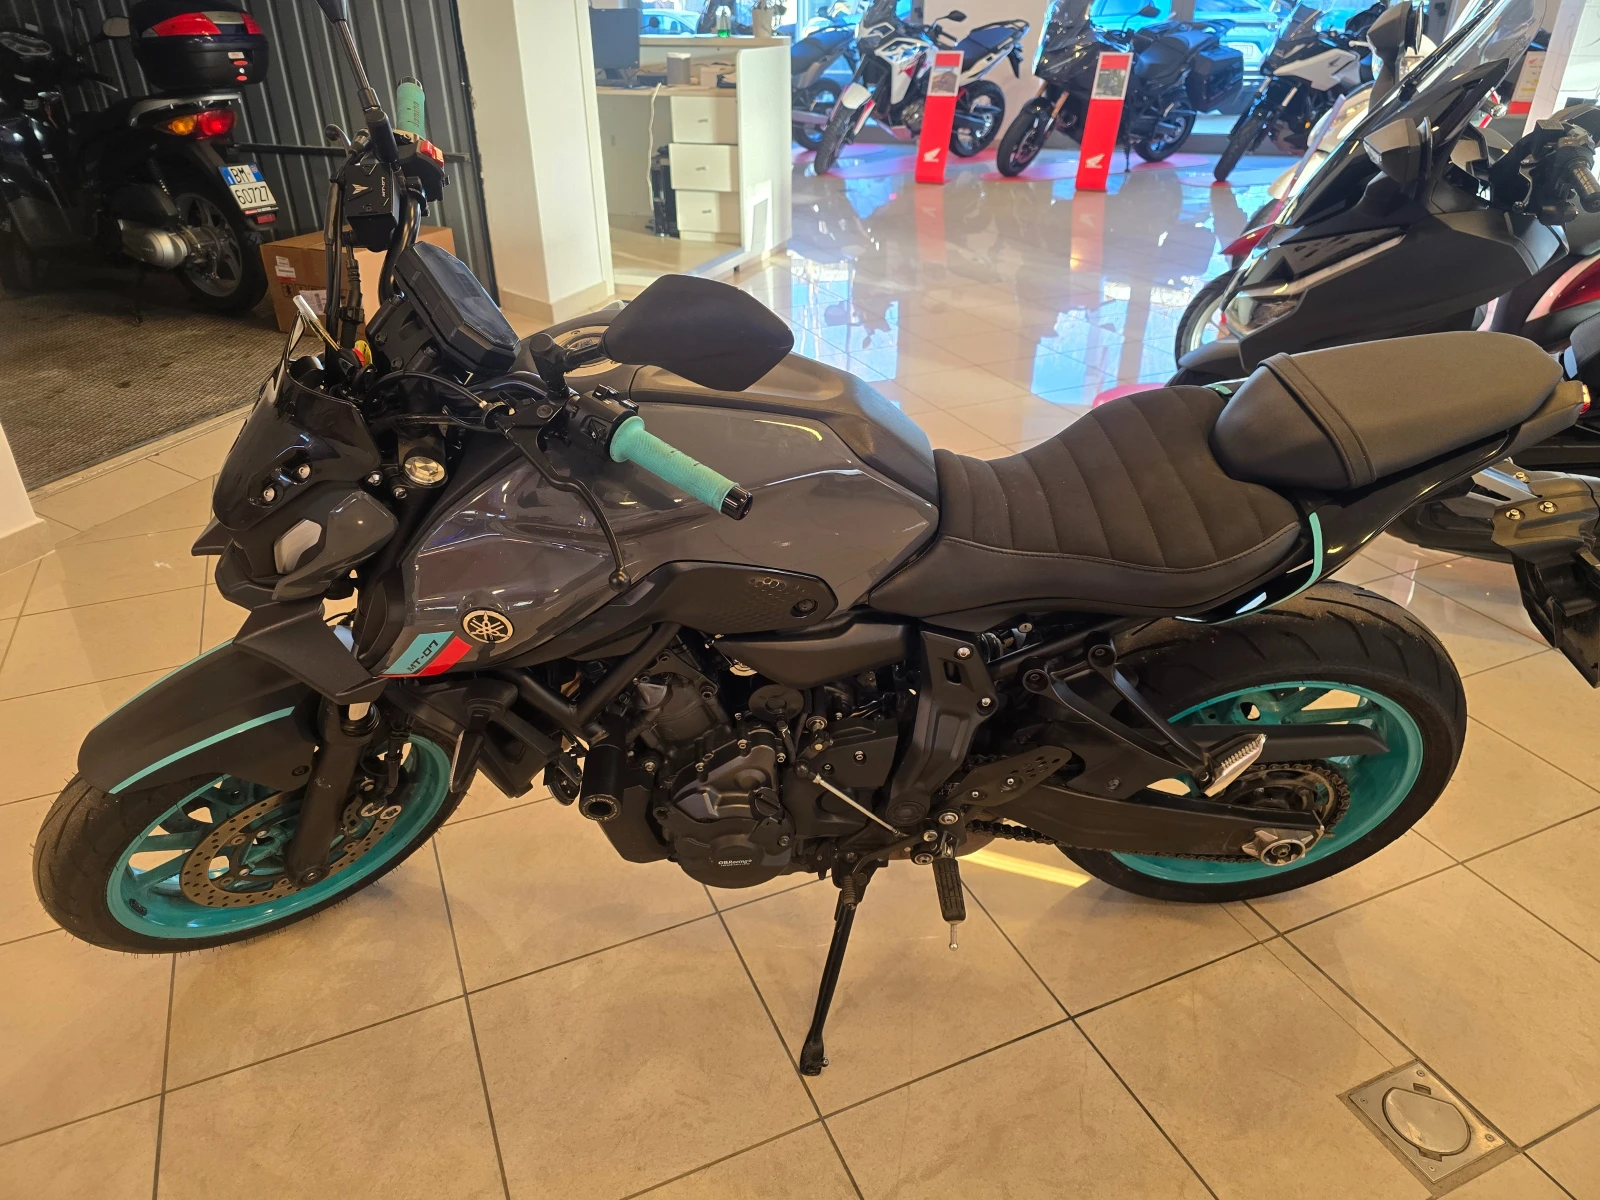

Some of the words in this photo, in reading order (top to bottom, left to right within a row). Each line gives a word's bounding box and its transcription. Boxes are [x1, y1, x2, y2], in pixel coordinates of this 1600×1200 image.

[231, 167, 250, 183] BM
[235, 186, 270, 204] 60727
[407, 639, 439, 672] MT-07
